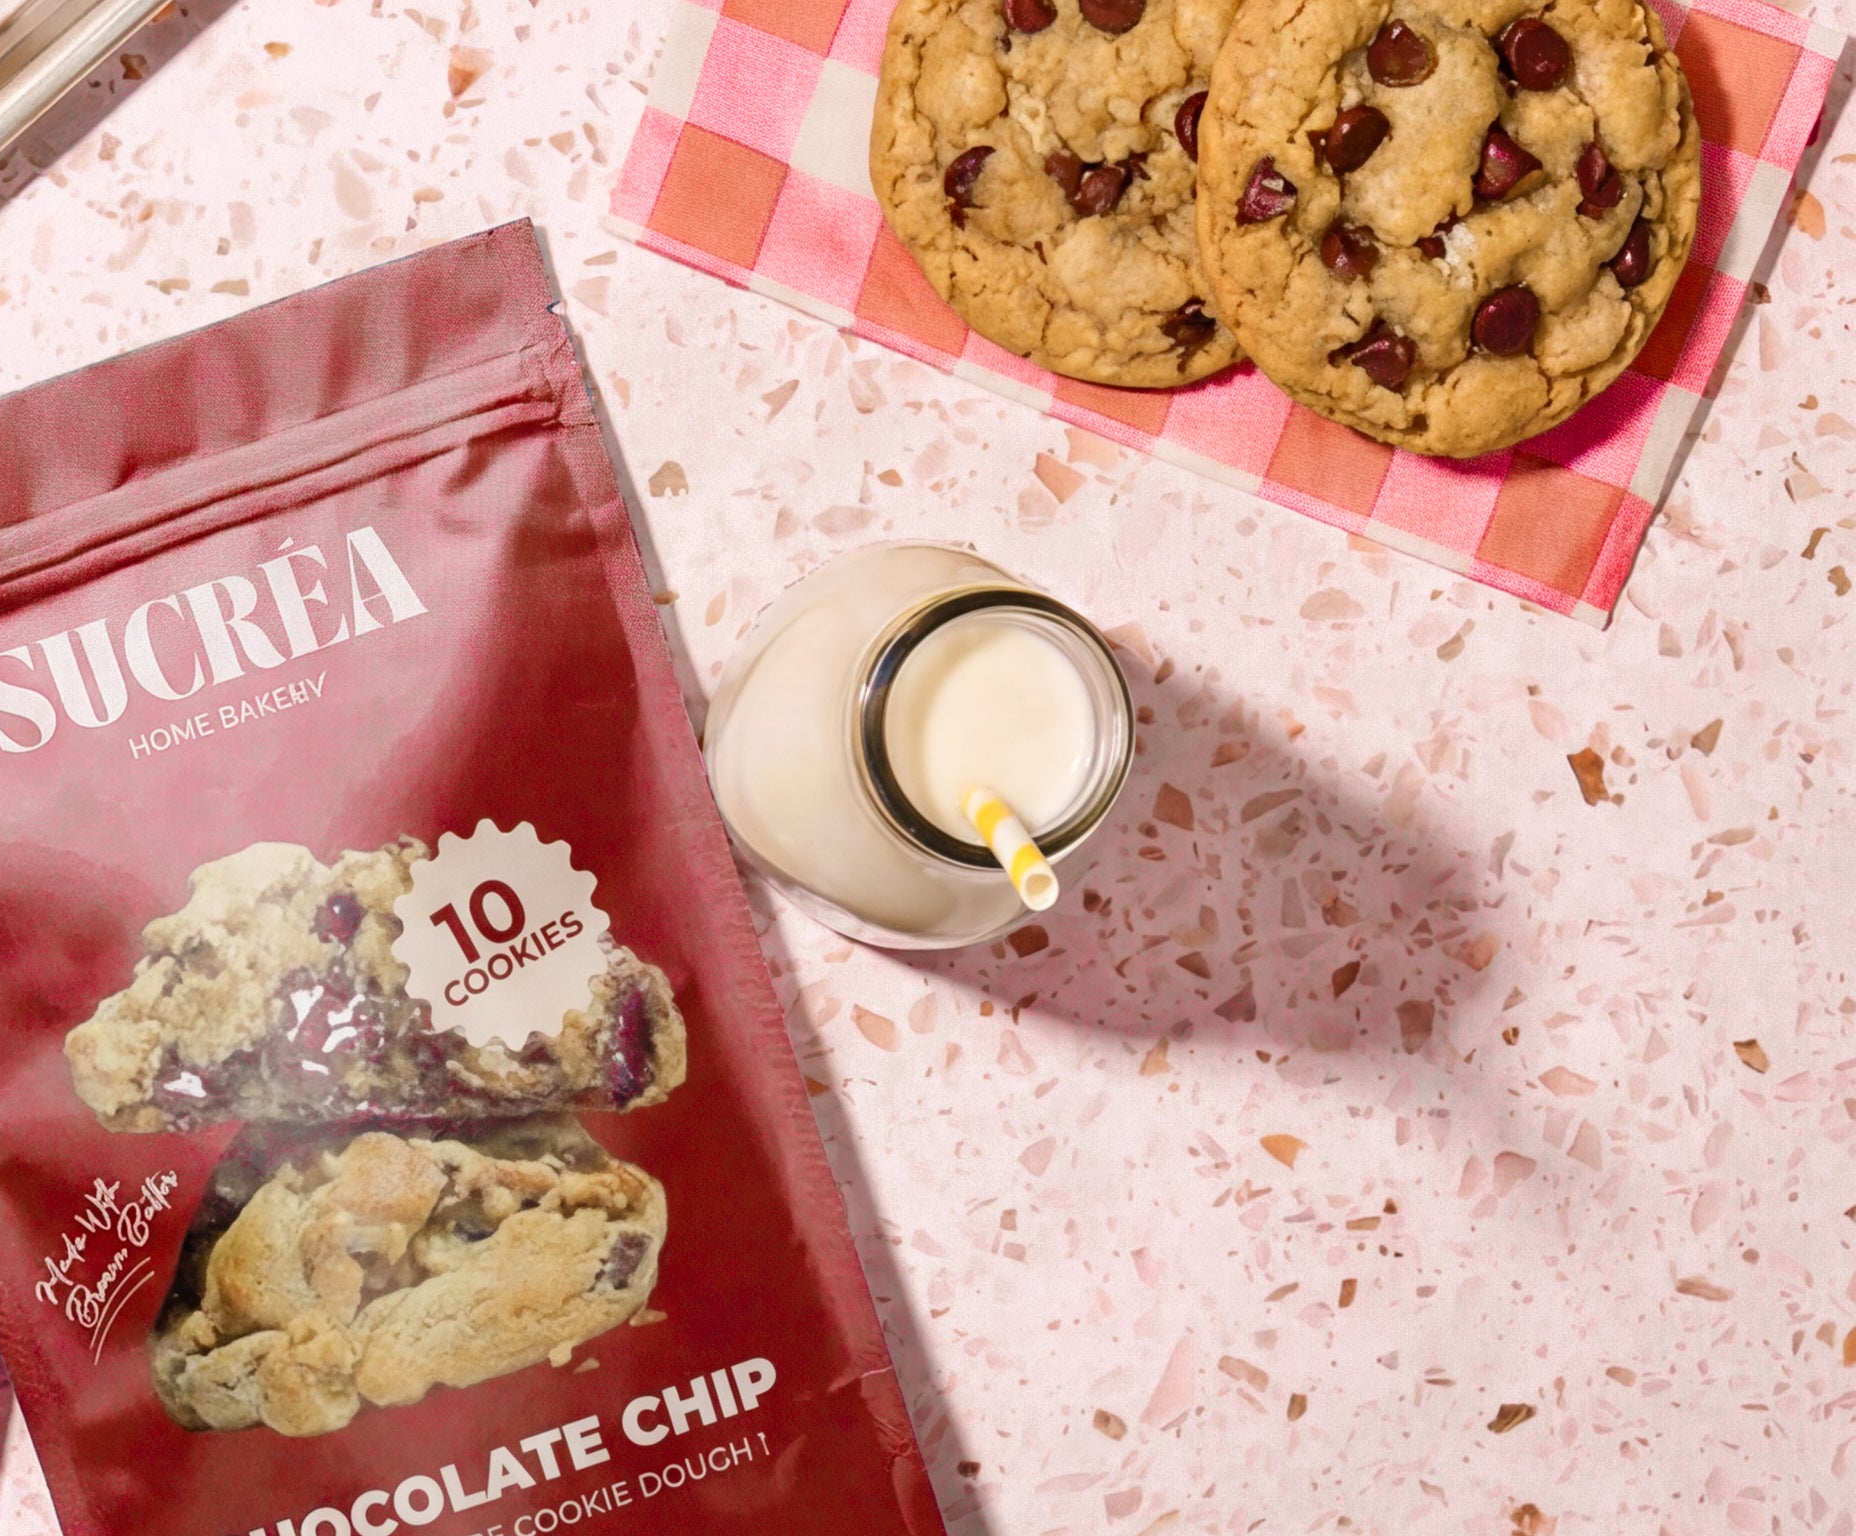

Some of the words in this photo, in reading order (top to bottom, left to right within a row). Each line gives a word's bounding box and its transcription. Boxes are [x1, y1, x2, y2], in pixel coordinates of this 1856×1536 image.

[128, 713, 215, 759] HOME
[429, 879, 526, 964] 10
[444, 910, 584, 1007] COOKIES
[621, 1357, 777, 1447] CHIP
